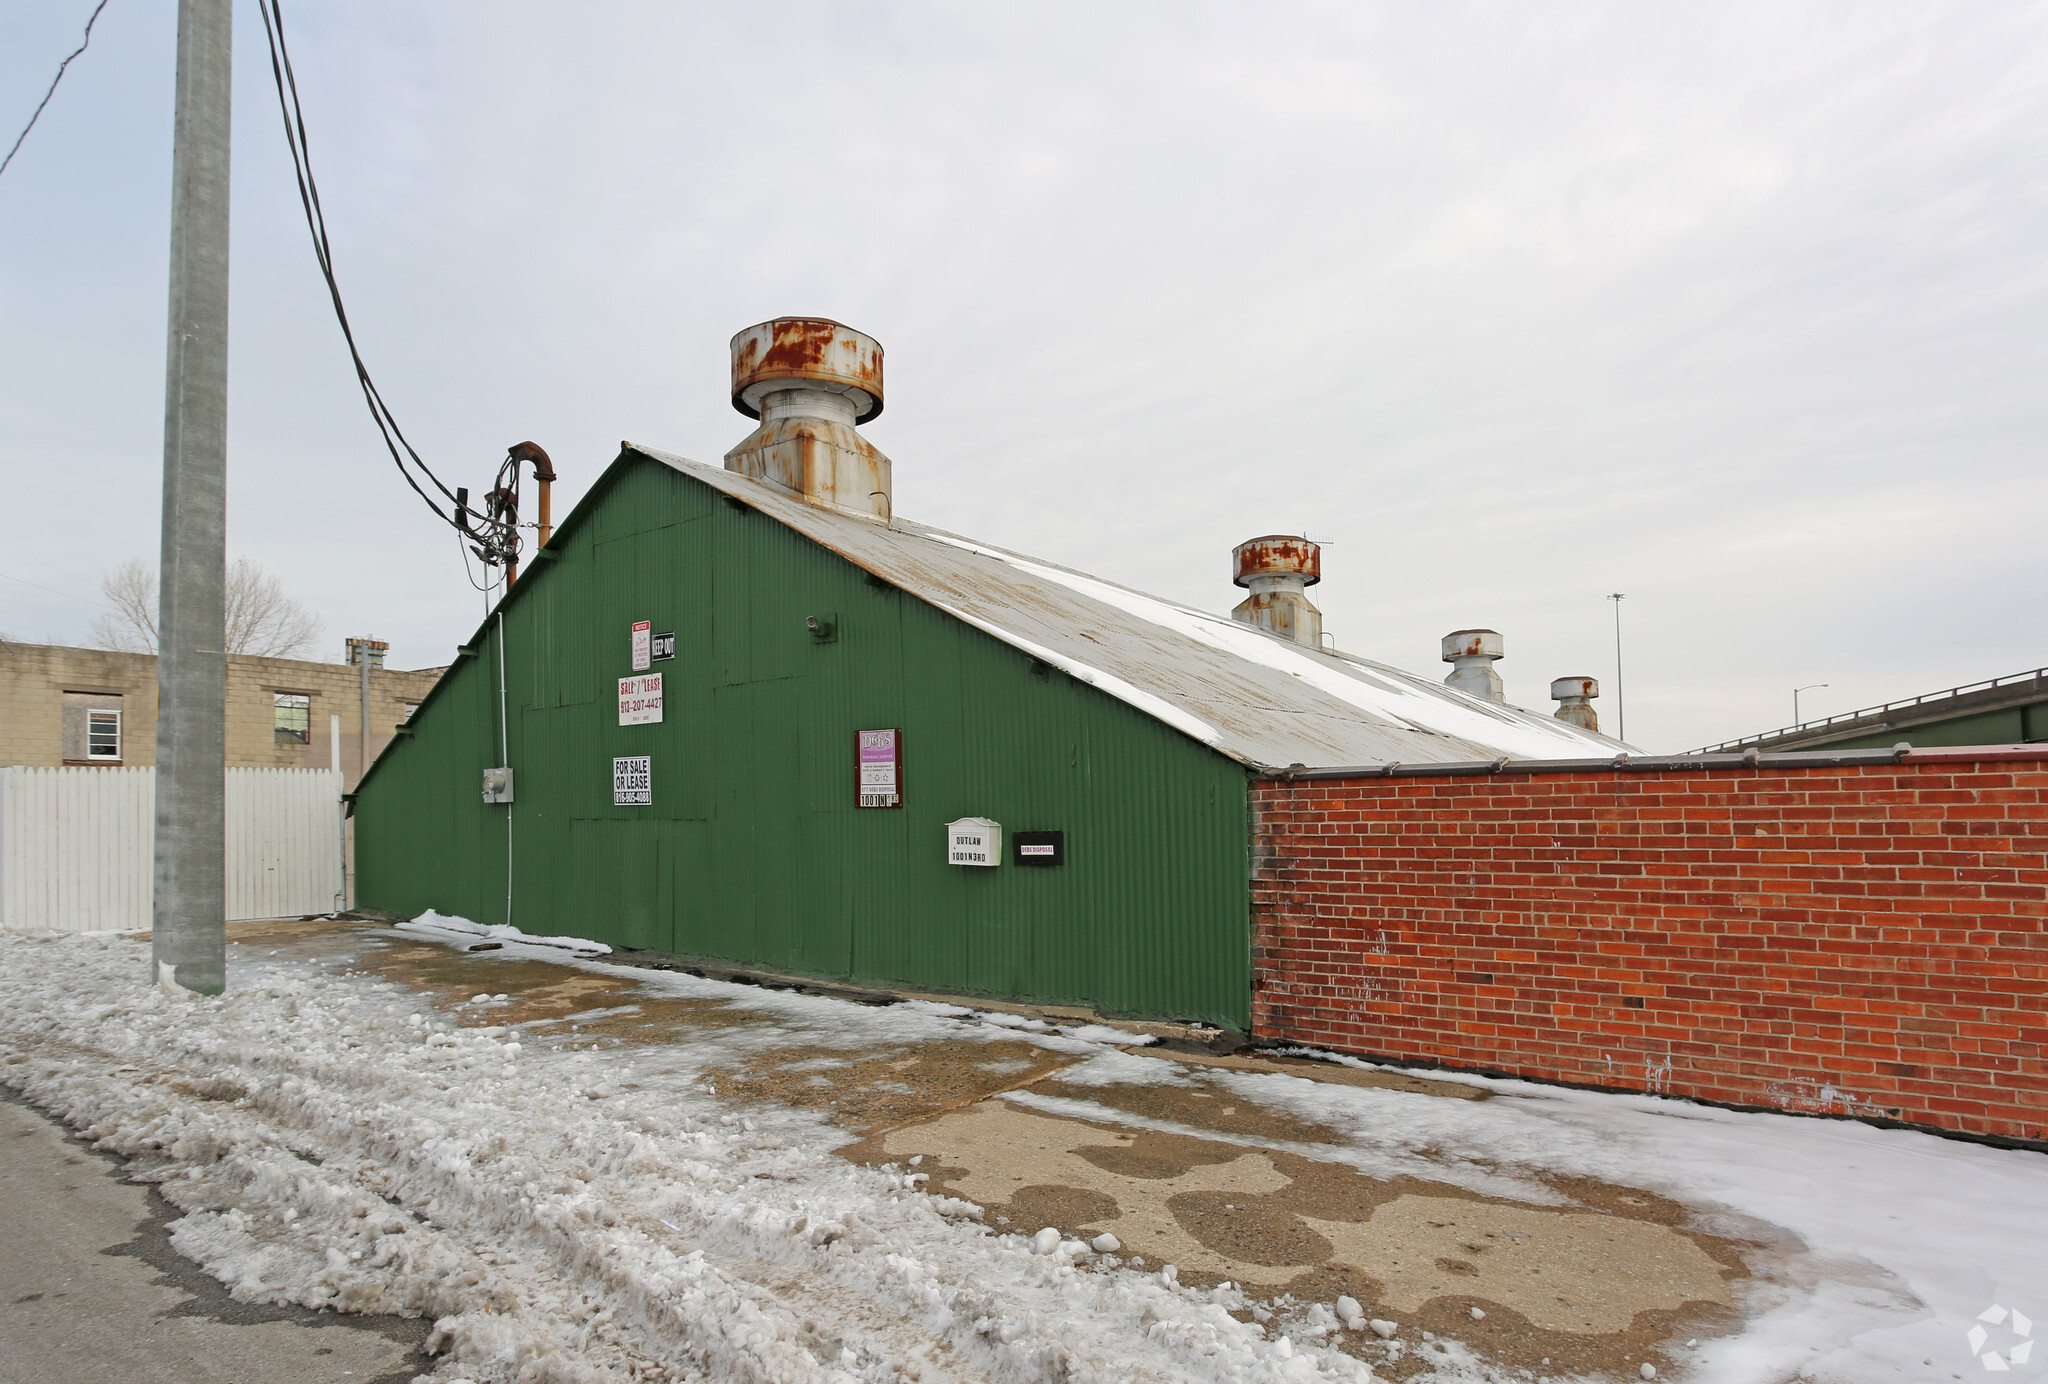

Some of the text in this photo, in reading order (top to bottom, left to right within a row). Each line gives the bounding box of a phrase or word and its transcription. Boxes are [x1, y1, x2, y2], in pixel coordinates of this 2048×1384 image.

[664, 637, 675, 654] OUT
[621, 681, 634, 695] SALE
[644, 678, 660, 692] LEASE
[621, 697, 662, 713] 913-207-4427
[616, 760, 647, 774] FOR SALE
[616, 775, 647, 789] OR LEASE
[861, 795, 879, 806] 1001
[880, 795, 885, 806] N
[956, 836, 982, 846] OUTLAW
